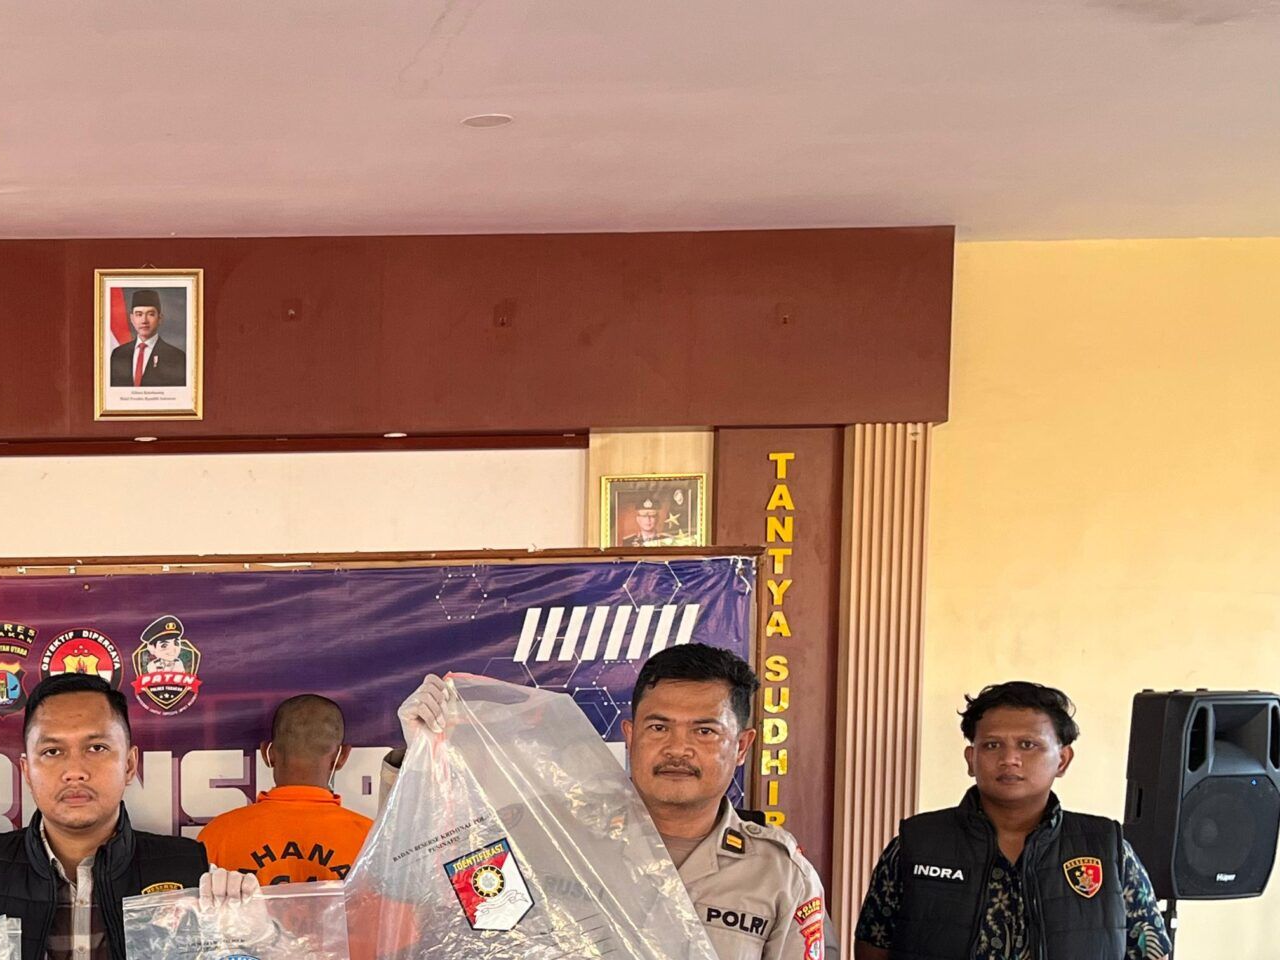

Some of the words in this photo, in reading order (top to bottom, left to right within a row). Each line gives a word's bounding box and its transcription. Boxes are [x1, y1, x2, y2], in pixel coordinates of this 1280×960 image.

[766, 452, 795, 638] TANTYA
[41, 631, 74, 671] OBYEKTIF
[82, 630, 121, 670] DIPERCAYA
[141, 674, 196, 685] PATEN
[453, 843, 503, 871] IDENTIFIKASI
[913, 864, 964, 881] INDRA
[706, 907, 768, 936] POLRI
